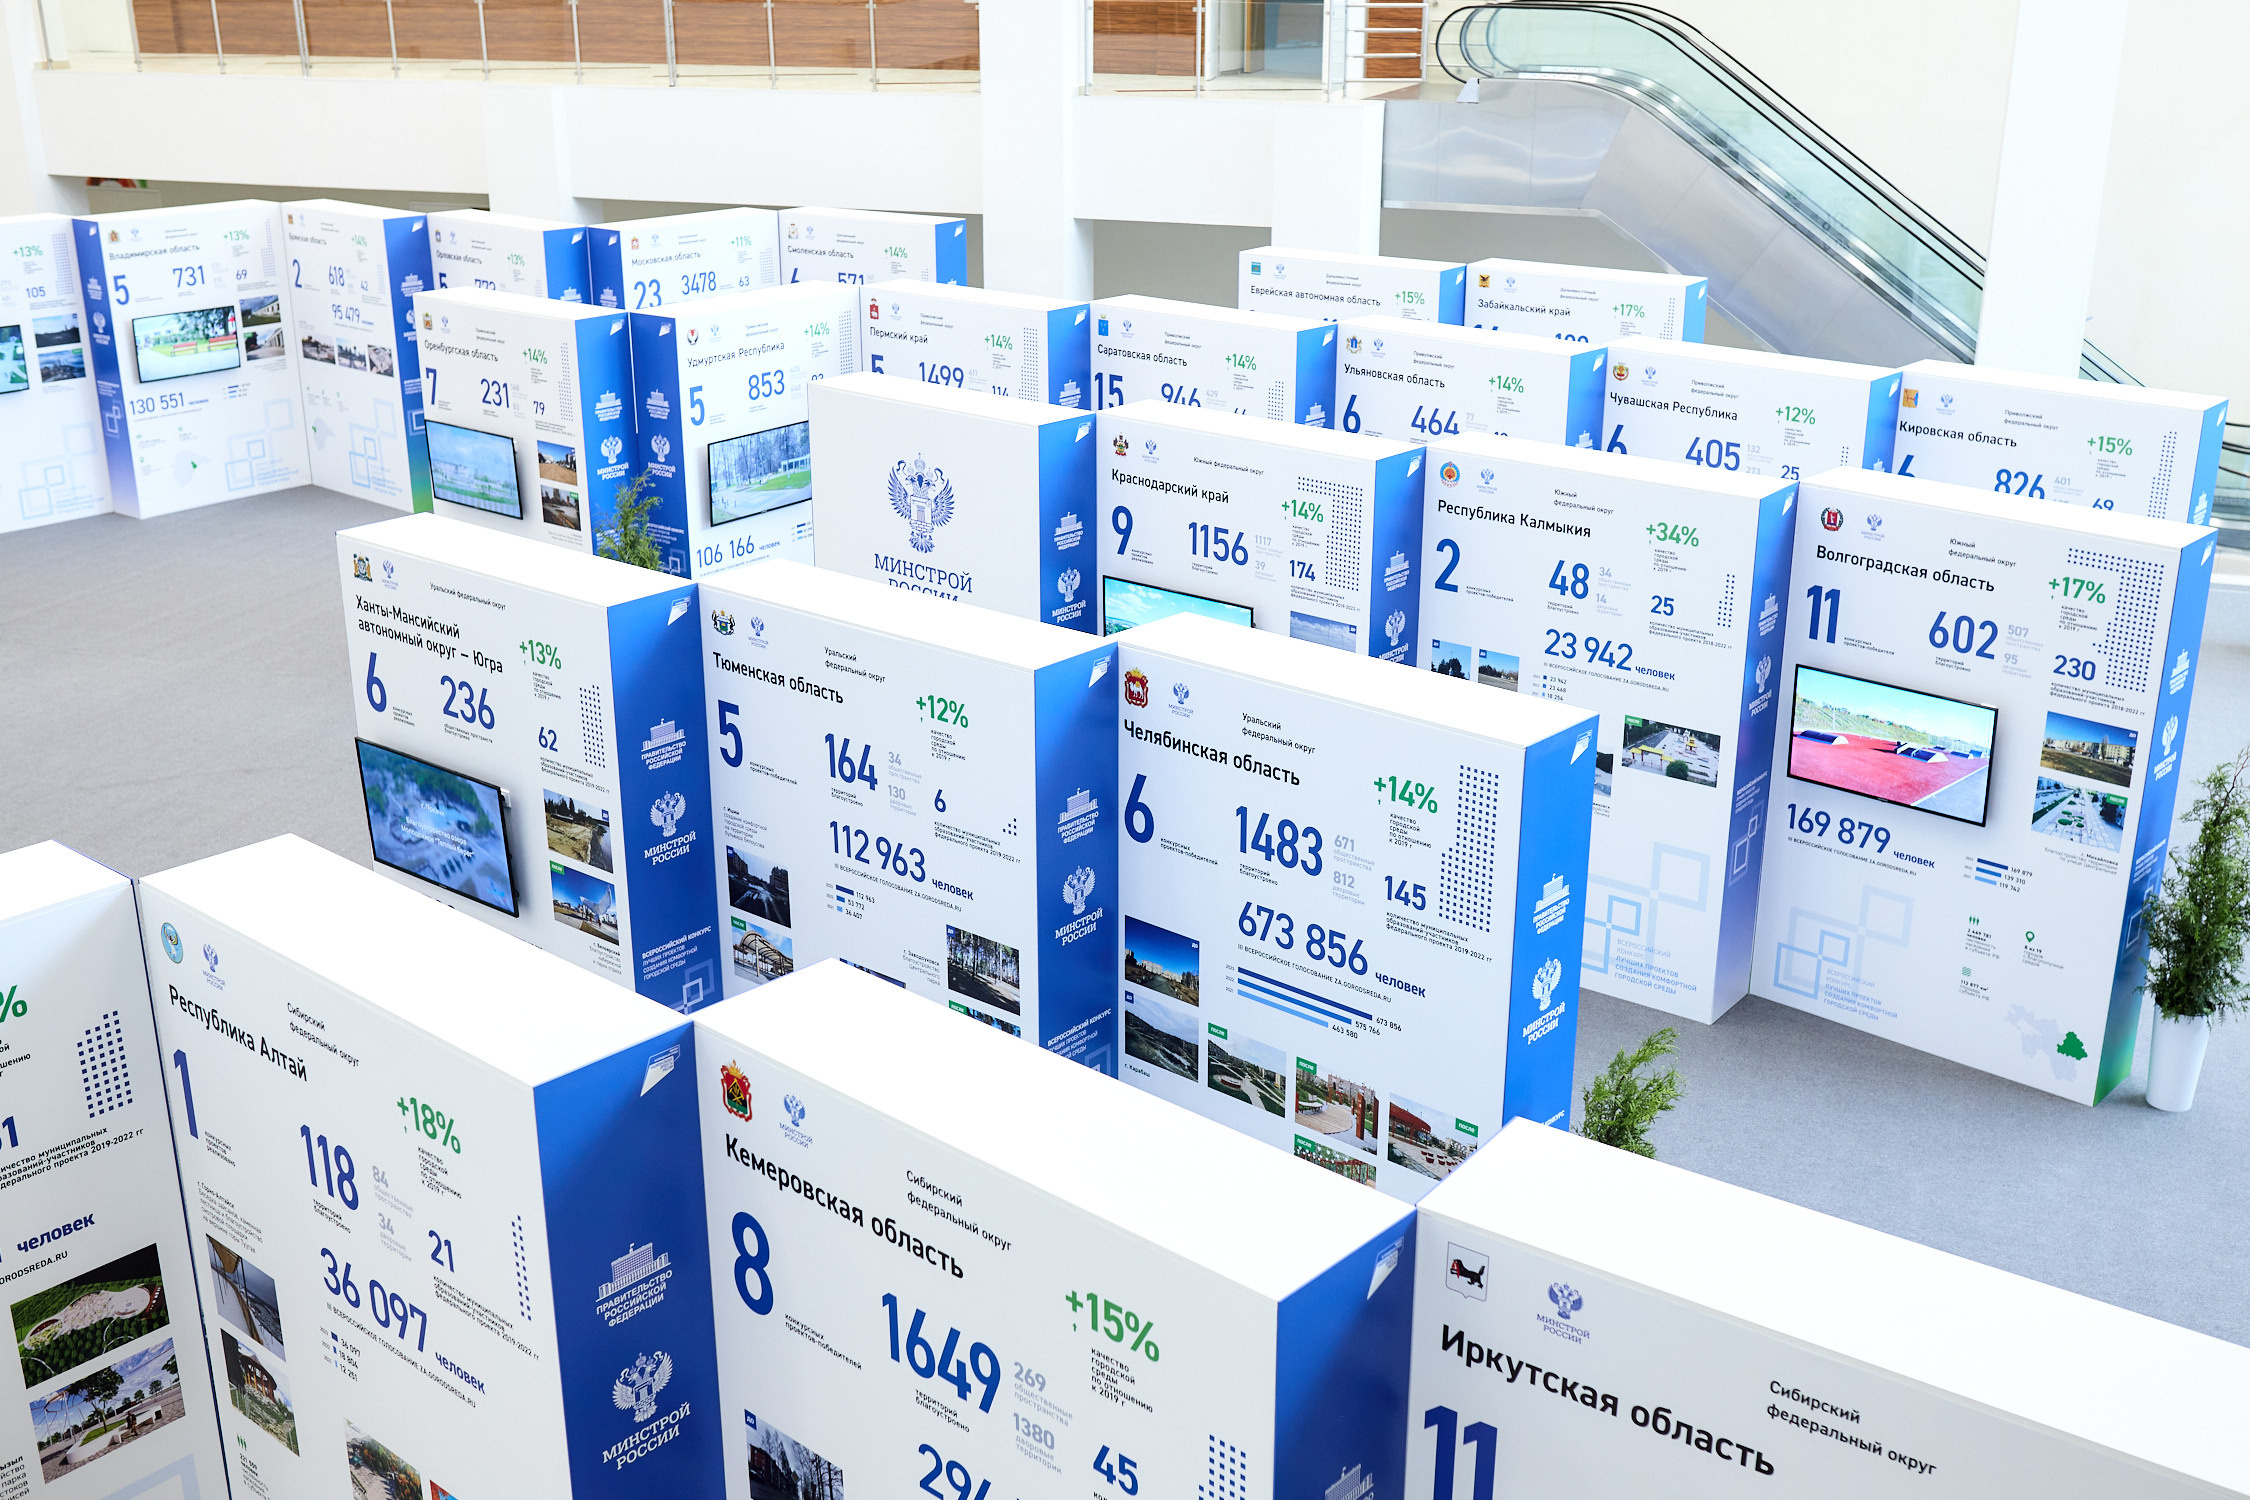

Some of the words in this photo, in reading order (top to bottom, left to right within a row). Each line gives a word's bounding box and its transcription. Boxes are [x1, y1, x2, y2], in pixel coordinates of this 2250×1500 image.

[109, 248, 168, 261] Владимирская
[169, 244, 200, 257] область
[632, 254, 673, 266] Московская
[675, 251, 701, 262] область
[787, 245, 825, 257] Смоленская
[827, 247, 854, 259] область
[113, 275, 130, 305] 5
[172, 265, 206, 288] 731
[293, 259, 302, 288] 2
[681, 271, 717, 295] 3478
[1250, 285, 1293, 299] Еврейская
[1295, 289, 1345, 304] автономная
[1347, 293, 1381, 308] область
[1394, 291, 1425, 305] +15%
[1478, 298, 1548, 316] Забайкальский
[1550, 306, 1571, 318] край
[1612, 304, 1645, 318] +17%
[424, 339, 470, 359] Оренбургская
[471, 347, 498, 362] область
[870, 327, 908, 341] Пермский
[909, 334, 928, 345] край
[687, 352, 736, 368] Удмуртская
[738, 342, 785, 359] Республика
[1098, 344, 1151, 361] Саратовская
[1153, 355, 1188, 367] область
[1225, 353, 1257, 371] +14%
[426, 368, 437, 405] 7
[748, 370, 785, 400] 853
[1344, 363, 1404, 383] Ульяновская
[1406, 373, 1445, 388] область
[1488, 375, 1524, 393] +14%
[130, 396, 155, 415] 130
[160, 392, 185, 411] 551
[480, 379, 510, 408] 231
[689, 385, 705, 426] 5
[1610, 392, 1669, 411] Чувашская
[1672, 401, 1738, 421] Республика
[1411, 405, 1460, 436] 464
[1775, 405, 1816, 425] +12%
[1899, 421, 1964, 441] Кировская
[1968, 431, 2017, 448] область
[2087, 436, 2133, 456] +15%
[1685, 437, 1741, 471] 405
[1111, 469, 1198, 497] Краснодарский
[1201, 488, 1229, 504] край
[1281, 499, 1324, 523] +14%
[1437, 499, 1515, 526] Республика
[1519, 513, 1591, 538] Калмыкия
[1112, 505, 1133, 555] 9
[1188, 522, 1249, 566] 1156
[1646, 522, 1699, 548] +34%
[696, 545, 723, 568] 106
[729, 535, 755, 556] 166
[1434, 538, 1461, 593] 2
[1816, 544, 1928, 580] Волгоградская
[1932, 566, 1995, 592] область
[874, 553, 973, 593] МИНСТРОЙ
[1289, 560, 1316, 582] 174
[1548, 559, 1590, 600] 48
[1650, 595, 1675, 617] 25
[2048, 576, 2106, 604] +17%
[356, 594, 460, 639] Ханты-Мансийский
[1806, 585, 1841, 644] 11
[358, 619, 423, 649] автономный
[426, 637, 457, 661] округ
[473, 650, 503, 674] Югра
[1928, 611, 1999, 660] 602
[519, 639, 562, 670] +13%
[1544, 628, 1577, 660] 23
[1584, 635, 1634, 671] 942
[1635, 664, 1676, 681] человек
[2052, 654, 2096, 682] 230
[366, 652, 387, 713] 6
[713, 651, 785, 688] Тюменская
[789, 676, 844, 704] область
[440, 675, 495, 730] 236
[916, 694, 969, 728] +12%
[538, 726, 558, 753] 62
[718, 699, 743, 768] 5
[1241, 726, 1292, 748] федеральный
[1294, 741, 1316, 754] округ
[824, 732, 878, 791] 164
[1124, 718, 1228, 766] Челябинская
[1233, 753, 1300, 786] область
[934, 788, 947, 813] 6
[1124, 773, 1155, 844] 6
[1373, 775, 1438, 814] +14%
[1057, 811, 1099, 833] ПРАВИТЕЛЬСТВО
[1787, 803, 1831, 838] 169
[1837, 817, 1891, 854] 879
[1893, 849, 1935, 869] человек
[644, 831, 697, 858] МИНСТРОЙ
[652, 844, 690, 865] РОССИИ
[1236, 805, 1323, 877] 1483
[829, 820, 870, 866] 112
[876, 836, 926, 884] 963
[932, 877, 974, 901] человек
[1384, 875, 1427, 911] 145
[1055, 908, 1103, 939] МИНСТРОЙ
[1061, 922, 1098, 946] РОССИИ
[1238, 901, 1294, 950] 673
[1306, 923, 1369, 976] 856
[1375, 971, 1426, 999] человек
[169, 983, 255, 1052] Республика
[260, 1037, 308, 1081] Алтай
[287, 1002, 326, 1031] Сибирский
[1522, 1001, 1566, 1038] МИНСТРОЙ
[1527, 1018, 1559, 1045] РОССИИ
[289, 1021, 338, 1055] федеральный
[340, 1047, 359, 1067] округ
[173, 1048, 199, 1139] 1
[397, 1097, 461, 1154] +18%
[38, 1127, 108, 1159] муниципальных
[54, 1150, 89, 1169] проекта
[91, 1131, 134, 1154] 2019-2022
[300, 1124, 359, 1211] 118
[906, 1170, 963, 1207] Сибирский
[725, 1133, 864, 1227] Кемеровская
[871, 1216, 964, 1279] область
[907, 1191, 979, 1235] федеральный
[982, 1230, 1012, 1251] округ
[17, 1212, 95, 1254] человек
[428, 1229, 455, 1273] 21
[731, 1211, 774, 1315] 8
[597, 1268, 673, 1315] ПРАВИТЕЛЬСТВО
[603, 1283, 668, 1321] РОССИЙСКОЙ
[320, 1247, 360, 1309] 36
[369, 1279, 427, 1352] 097
[435, 1351, 485, 1395] человек
[608, 1294, 664, 1328] ФЕДЕРАЦИИ
[785, 1313, 825, 1340] конкурсных
[1065, 1290, 1160, 1363] +15%
[785, 1321, 862, 1370] проектов-победителей
[881, 1292, 1001, 1414] 1649
[1091, 1347, 1130, 1372] качество
[1013, 1361, 1047, 1392] 269
[1091, 1357, 1136, 1385] городской
[1091, 1366, 1118, 1385] среды
[915, 1388, 958, 1418] территорий
[1099, 1386, 1119, 1405] 2019
[1440, 1325, 1619, 1418] Иркутская
[1630, 1405, 1775, 1477] область
[1769, 1380, 1861, 1424] Сибирский
[915, 1395, 970, 1433] благоустроено
[1013, 1412, 1055, 1450] 1380
[602, 1402, 691, 1464] МИНСТРОЙ
[616, 1424, 680, 1471] РОССИИ
[1766, 1402, 1882, 1456] федеральный
[1887, 1447, 1937, 1478] округ
[1093, 1444, 1139, 1496] 45
